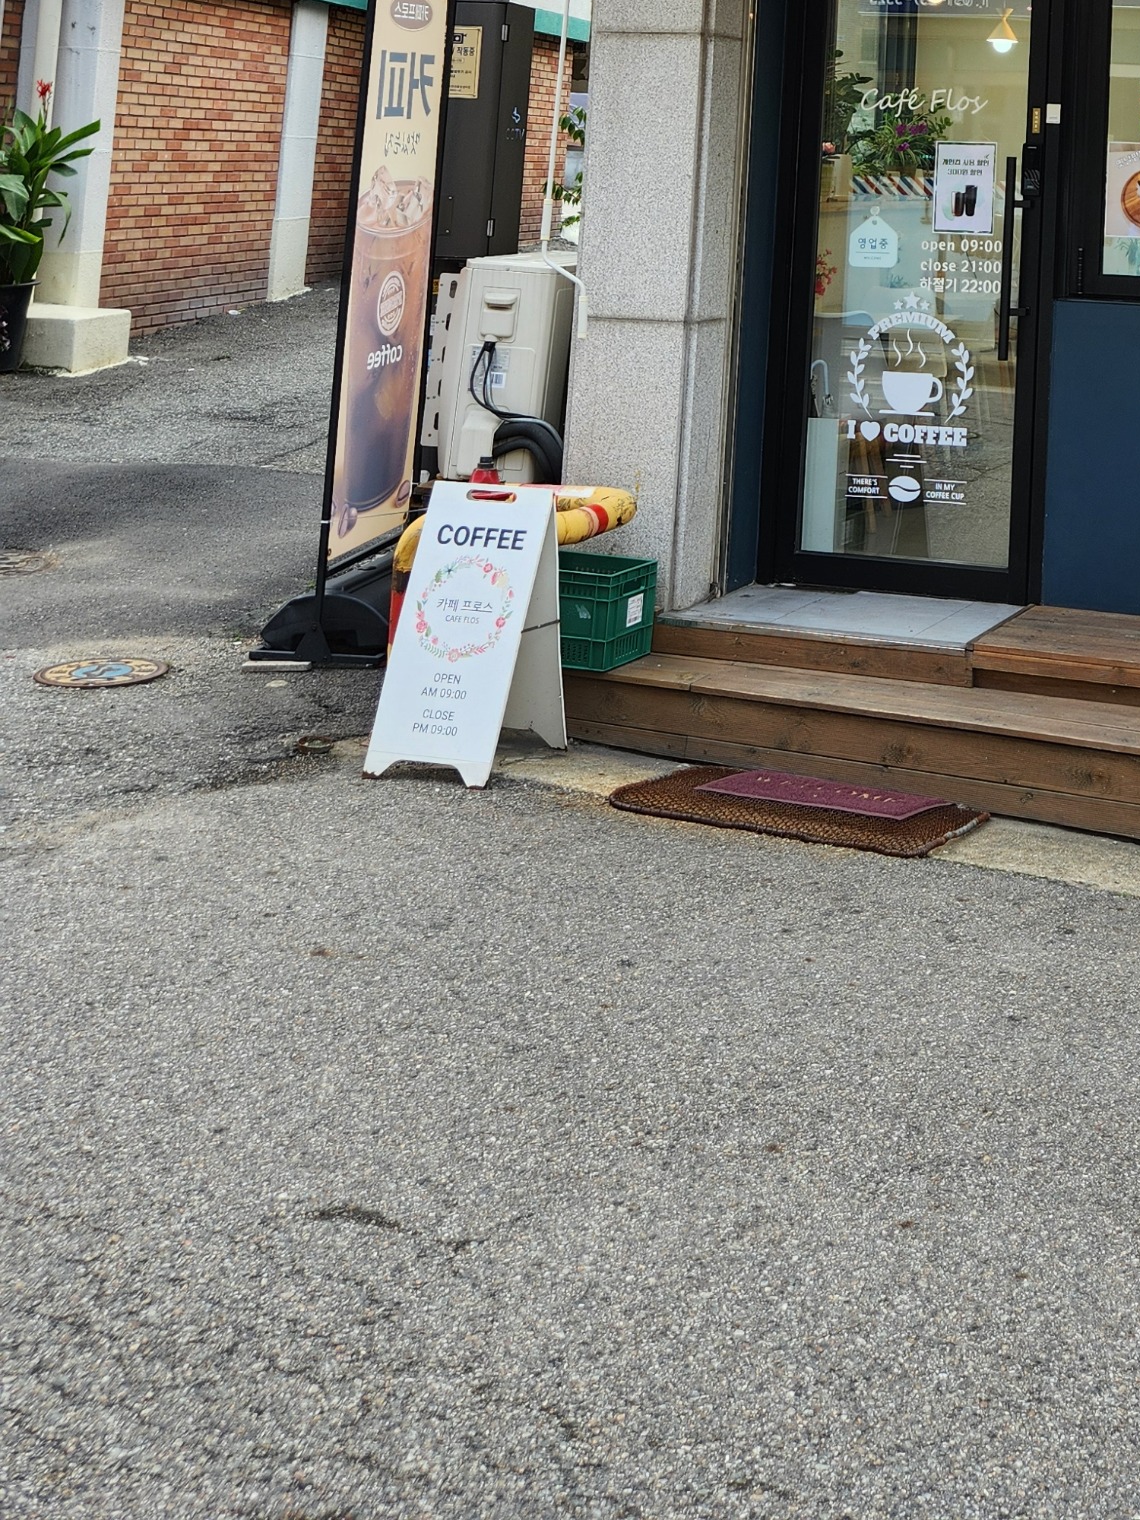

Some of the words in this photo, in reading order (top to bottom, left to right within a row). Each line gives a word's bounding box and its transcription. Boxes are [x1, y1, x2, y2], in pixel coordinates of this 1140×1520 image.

[861, 86, 926, 117] Café
[930, 89, 990, 114] Flos
[858, 237, 889, 250] 영업중
[921, 240, 955, 252] open
[961, 239, 1002, 253] 09:00
[920, 258, 957, 272] close
[961, 260, 1001, 274] 21:00
[919, 277, 957, 293] 하절기
[961, 280, 1001, 294] 22:00
[867, 311, 956, 344] PREMIUM
[846, 420, 856, 439] I
[884, 423, 967, 447] COFFEE
[852, 478, 878, 486] THERE'S
[848, 486, 880, 494] COMFORT
[925, 491, 950, 499] COFFEE
[951, 492, 965, 500] CUP
[437, 524, 528, 551] COFFEE
[436, 597, 459, 612] 카페
[461, 599, 493, 614] 프로스
[445, 615, 462, 624] CAFE
[463, 616, 480, 625] FLOS
[433, 673, 461, 685] OPEN
[421, 687, 438, 698] AM
[440, 688, 467, 700] 09:00
[422, 708, 455, 721] CLOSE
[412, 722, 429, 734] PM
[430, 724, 458, 736] 09:00
